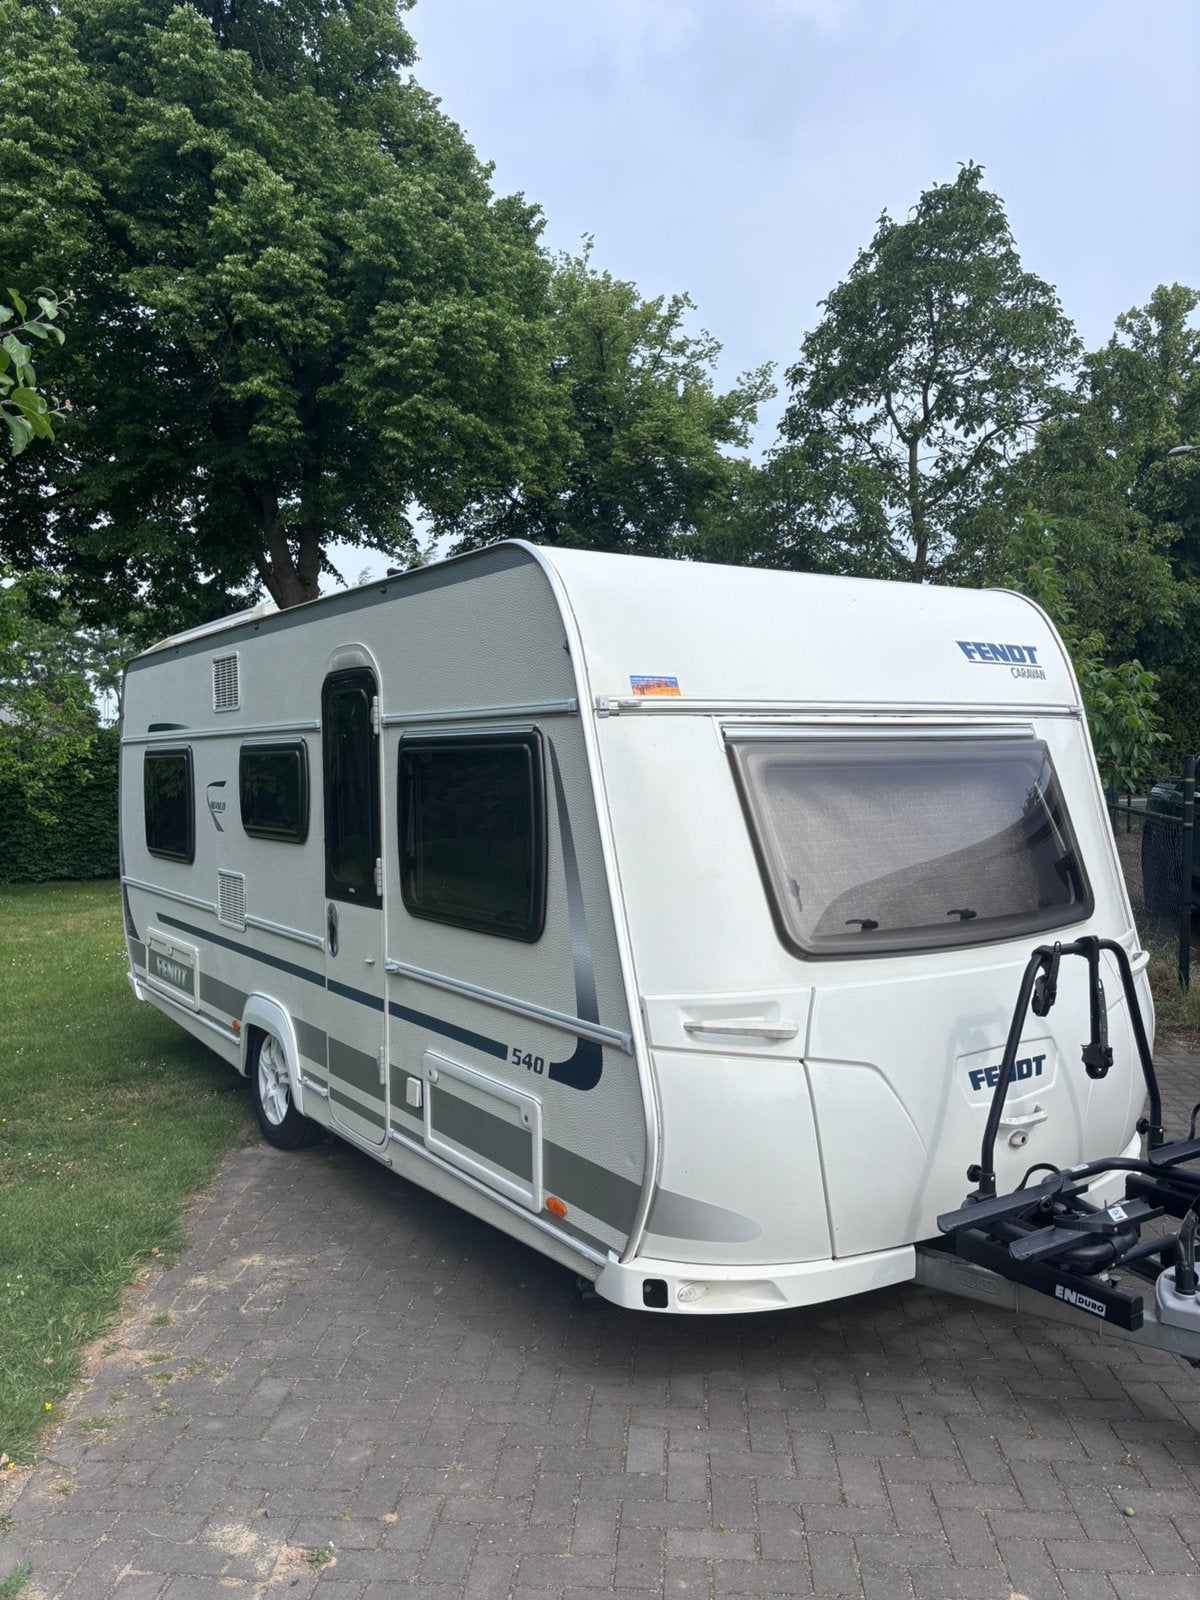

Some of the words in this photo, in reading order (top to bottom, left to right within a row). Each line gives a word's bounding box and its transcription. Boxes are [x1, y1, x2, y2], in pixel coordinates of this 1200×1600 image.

[955, 640, 1038, 664] FENDT
[1010, 667, 1046, 680] CARAVAN
[156, 956, 187, 987] FENDT
[511, 1047, 544, 1075] 540
[1054, 1284, 1106, 1317] ENDURO
